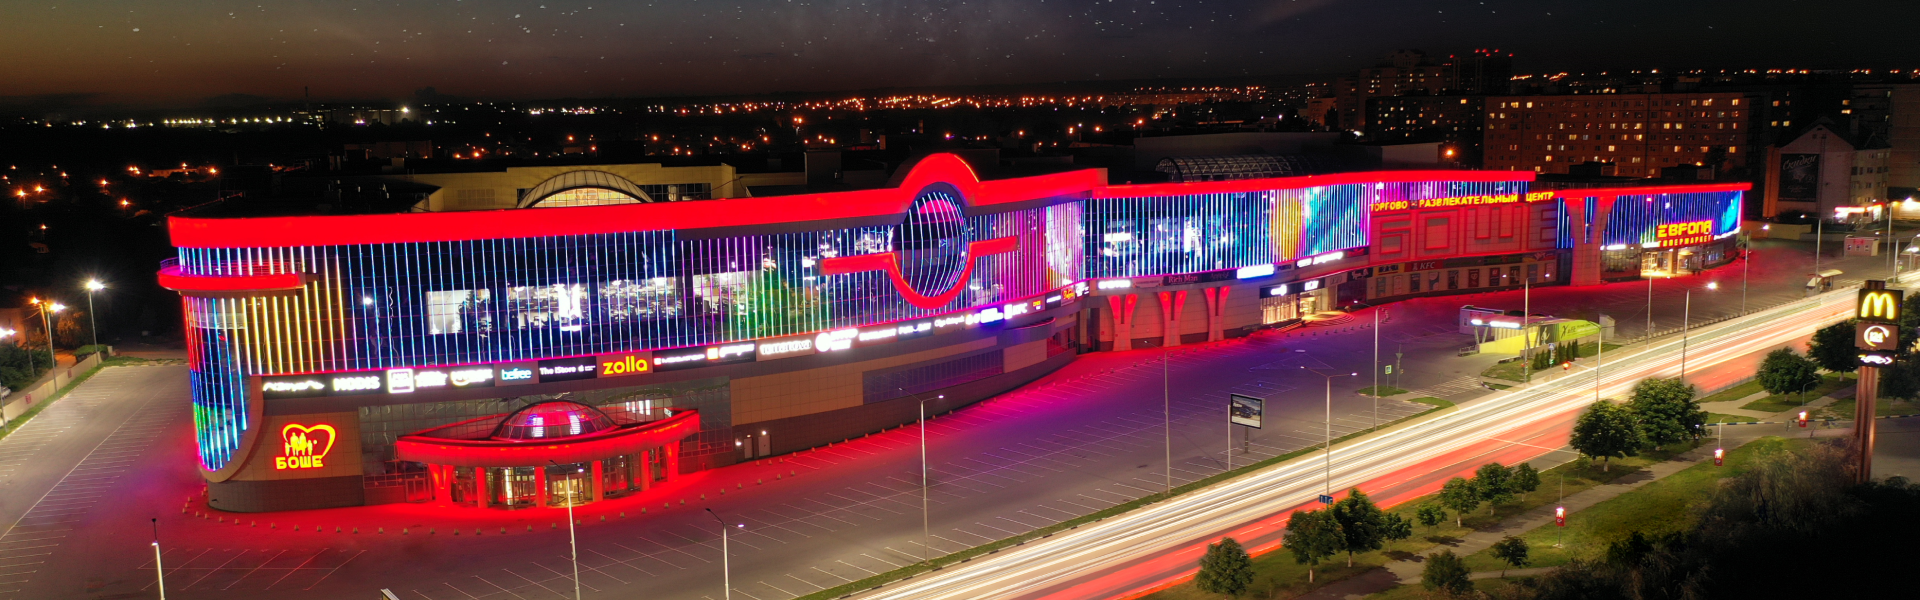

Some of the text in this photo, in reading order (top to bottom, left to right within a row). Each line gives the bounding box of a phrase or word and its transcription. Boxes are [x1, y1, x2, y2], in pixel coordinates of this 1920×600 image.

[1371, 200, 1408, 212] ТОРГОВО
[1419, 194, 1518, 208] РАЗВЛЕКАТЕЛЬНЫЙ
[1525, 191, 1554, 203] ЦЕНТР
[1420, 261, 1436, 270] KFC
[1168, 276, 1183, 284] Rich
[1184, 274, 1199, 282] Man
[539, 367, 554, 376] The
[602, 355, 648, 375] zolla
[501, 367, 532, 380] befree
[275, 455, 324, 470] БОШЕ
